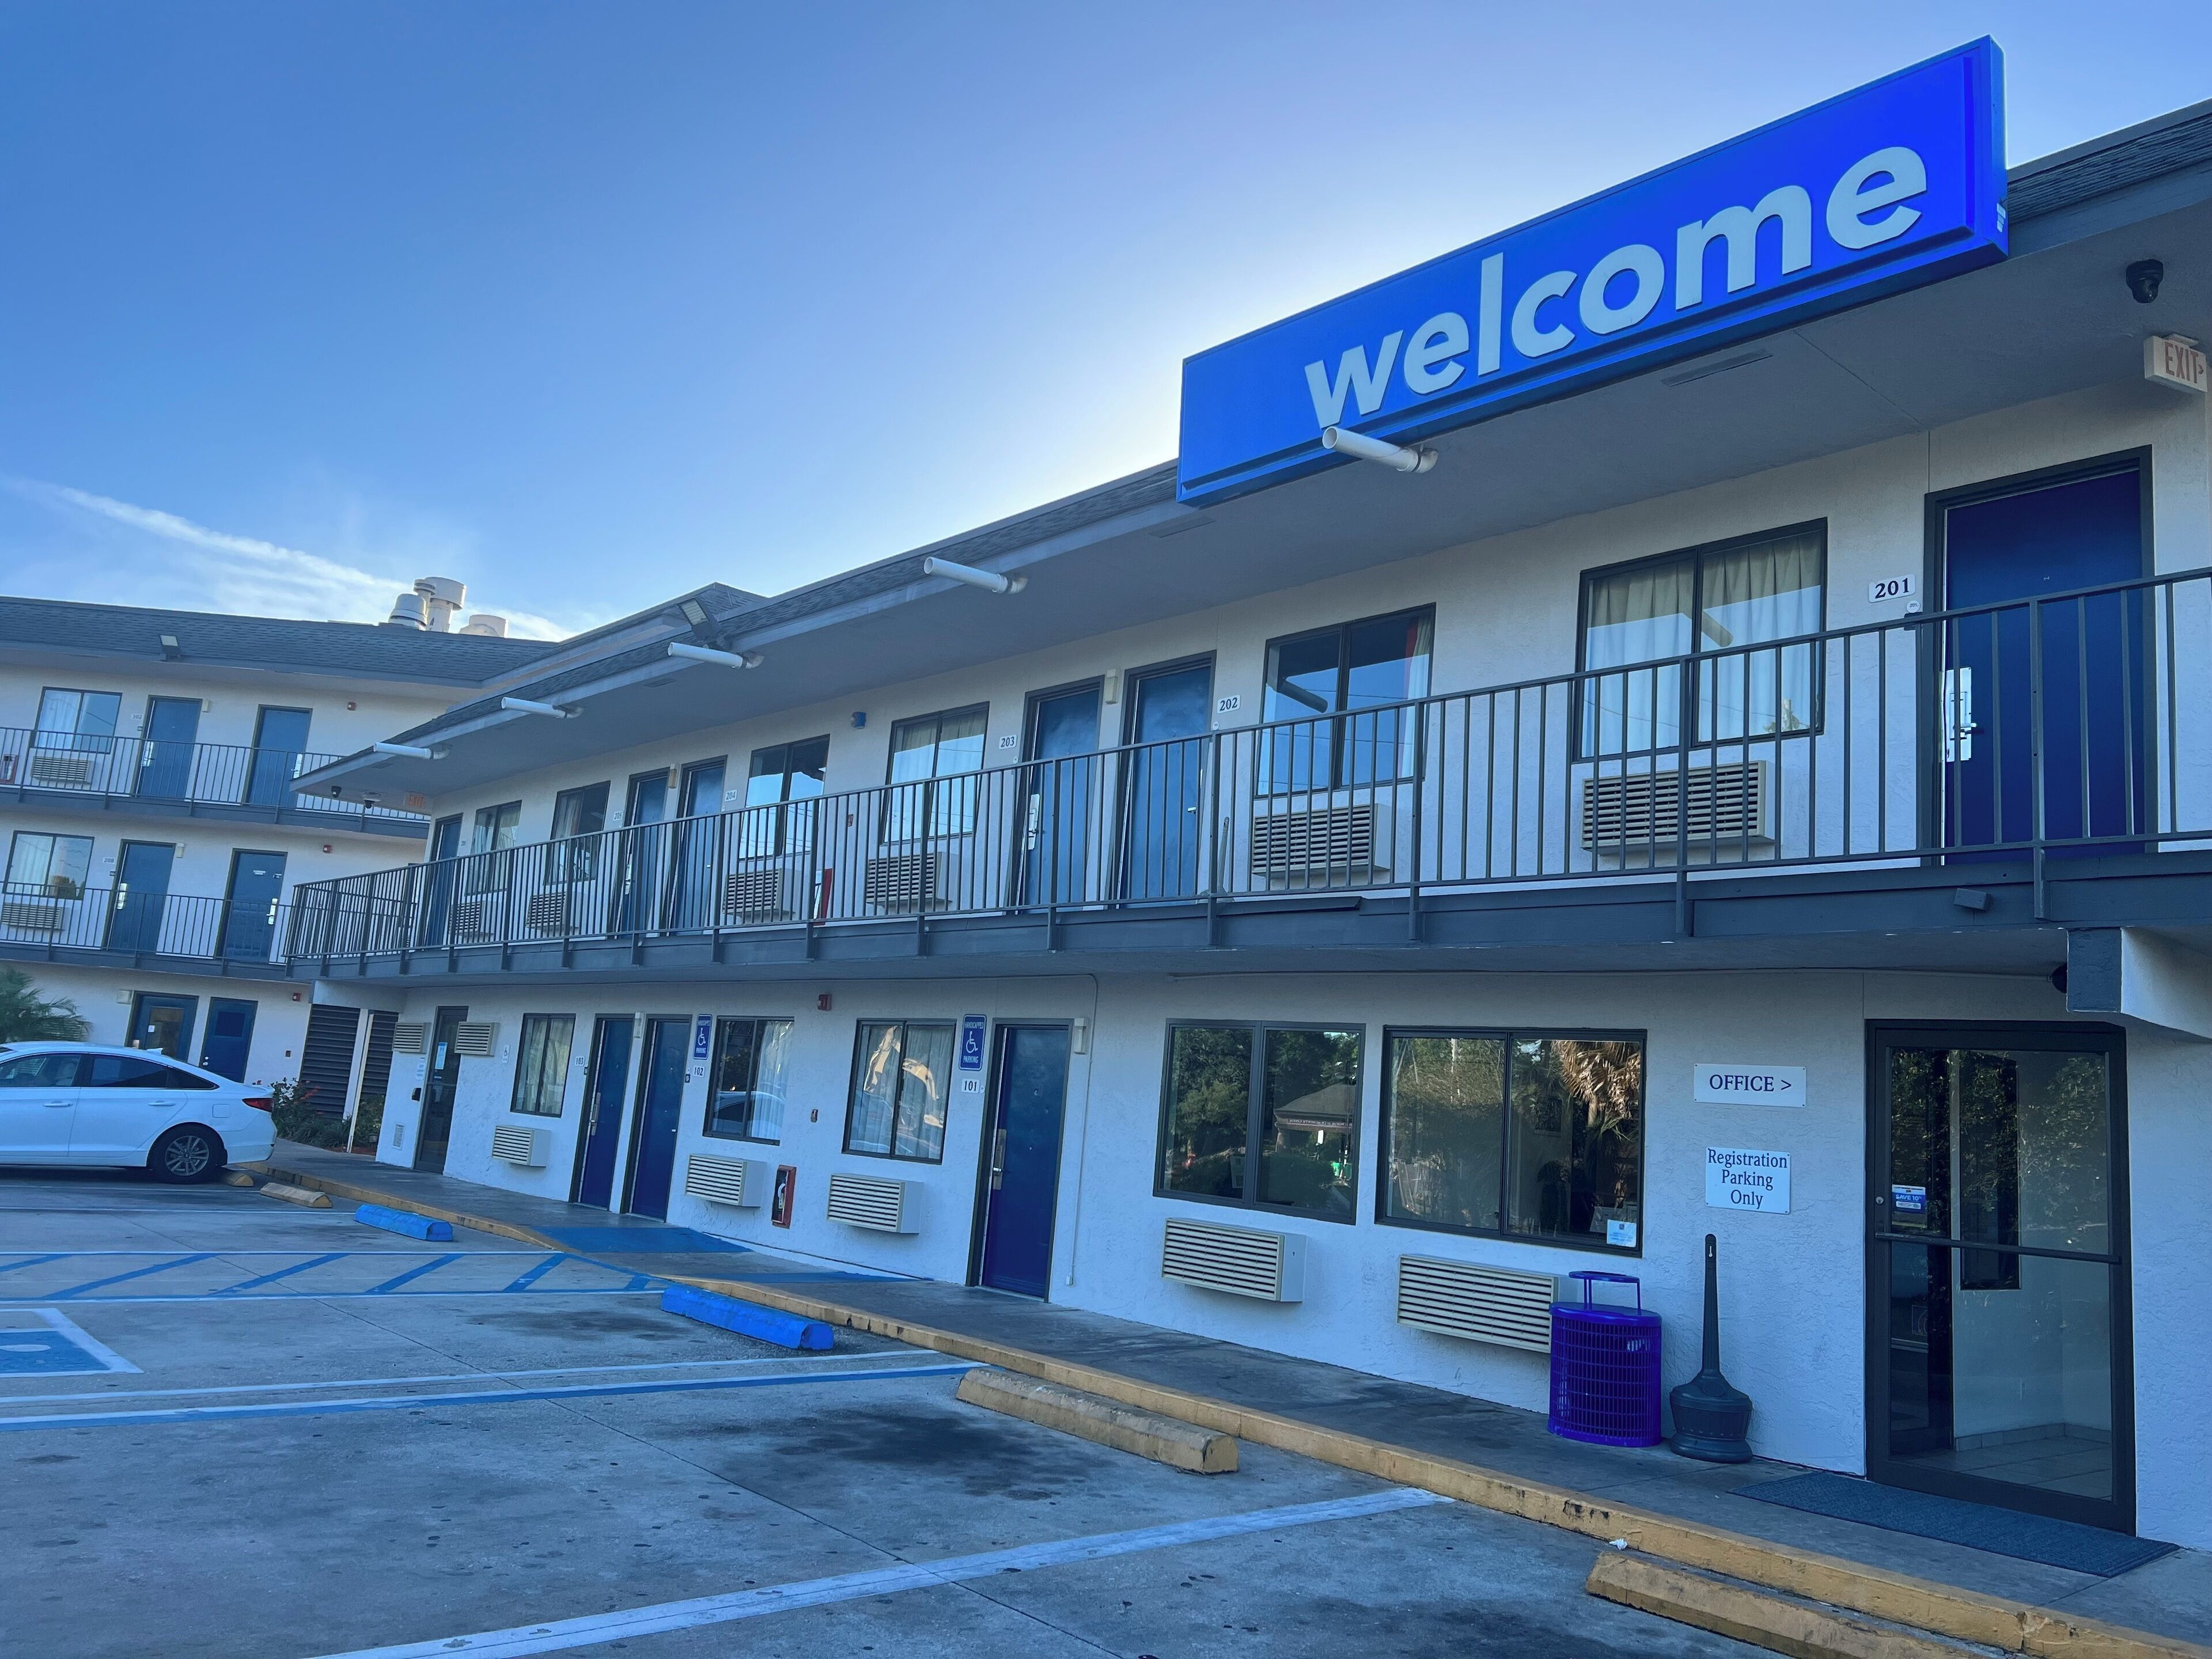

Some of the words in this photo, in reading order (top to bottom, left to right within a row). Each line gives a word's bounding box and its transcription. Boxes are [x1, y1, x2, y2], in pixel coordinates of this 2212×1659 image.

[1305, 147, 1927, 429] welcome
[2164, 341, 2199, 384] EXIT
[1874, 577, 1910, 599] 201
[1219, 697, 1238, 711] 202
[1000, 736, 1014, 748] 203
[726, 791, 736, 800] 204
[963, 1055, 979, 1063] PARKING
[694, 1067, 703, 1076] 102
[964, 1080, 978, 1092] 101
[1709, 1074, 1774, 1092] OFFICE
[1708, 1149, 1788, 1168] Registration
[1721, 1169, 1774, 1191] Parking
[1730, 1190, 1763, 1209] Only
